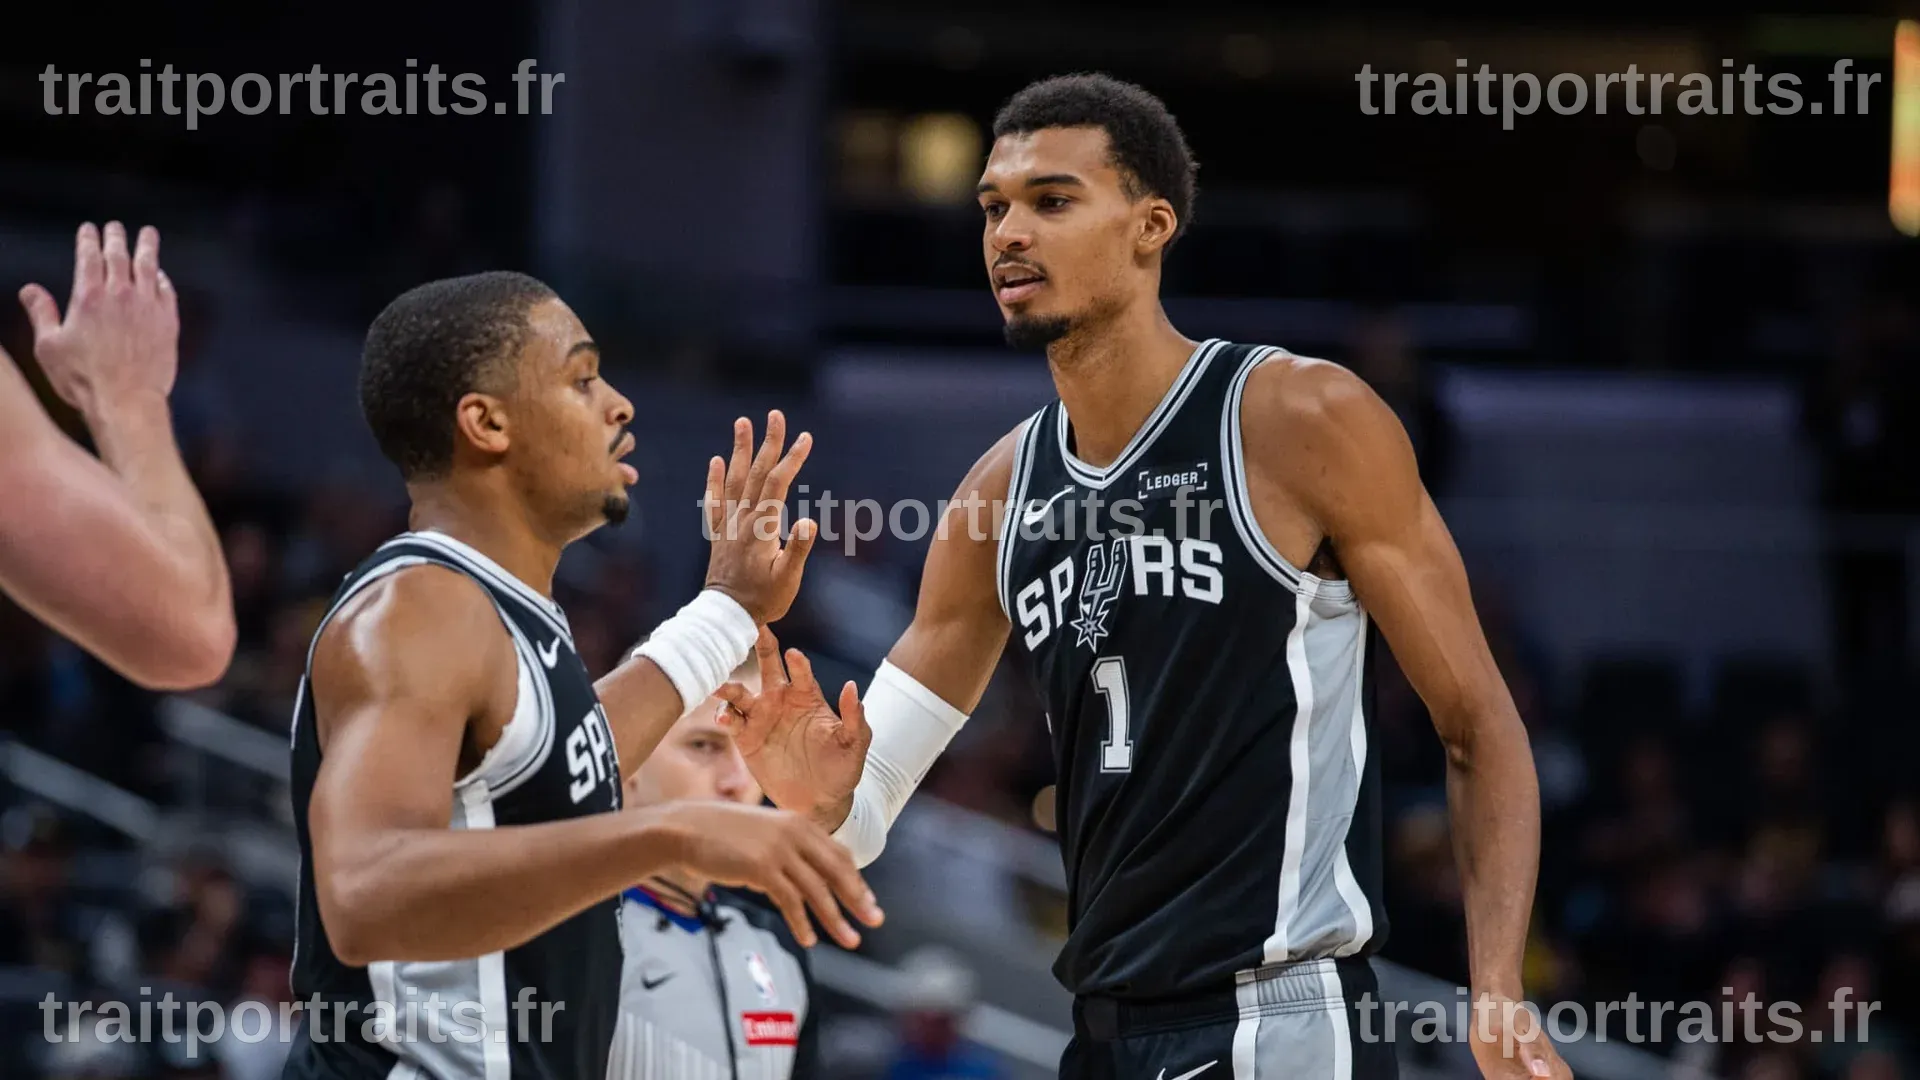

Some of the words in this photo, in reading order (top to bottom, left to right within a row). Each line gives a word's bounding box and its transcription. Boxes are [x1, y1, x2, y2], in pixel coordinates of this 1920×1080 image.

[1146, 471, 1198, 491] LEDGER
[1016, 535, 1224, 653] SPURS
[1090, 655, 1134, 773] 1
